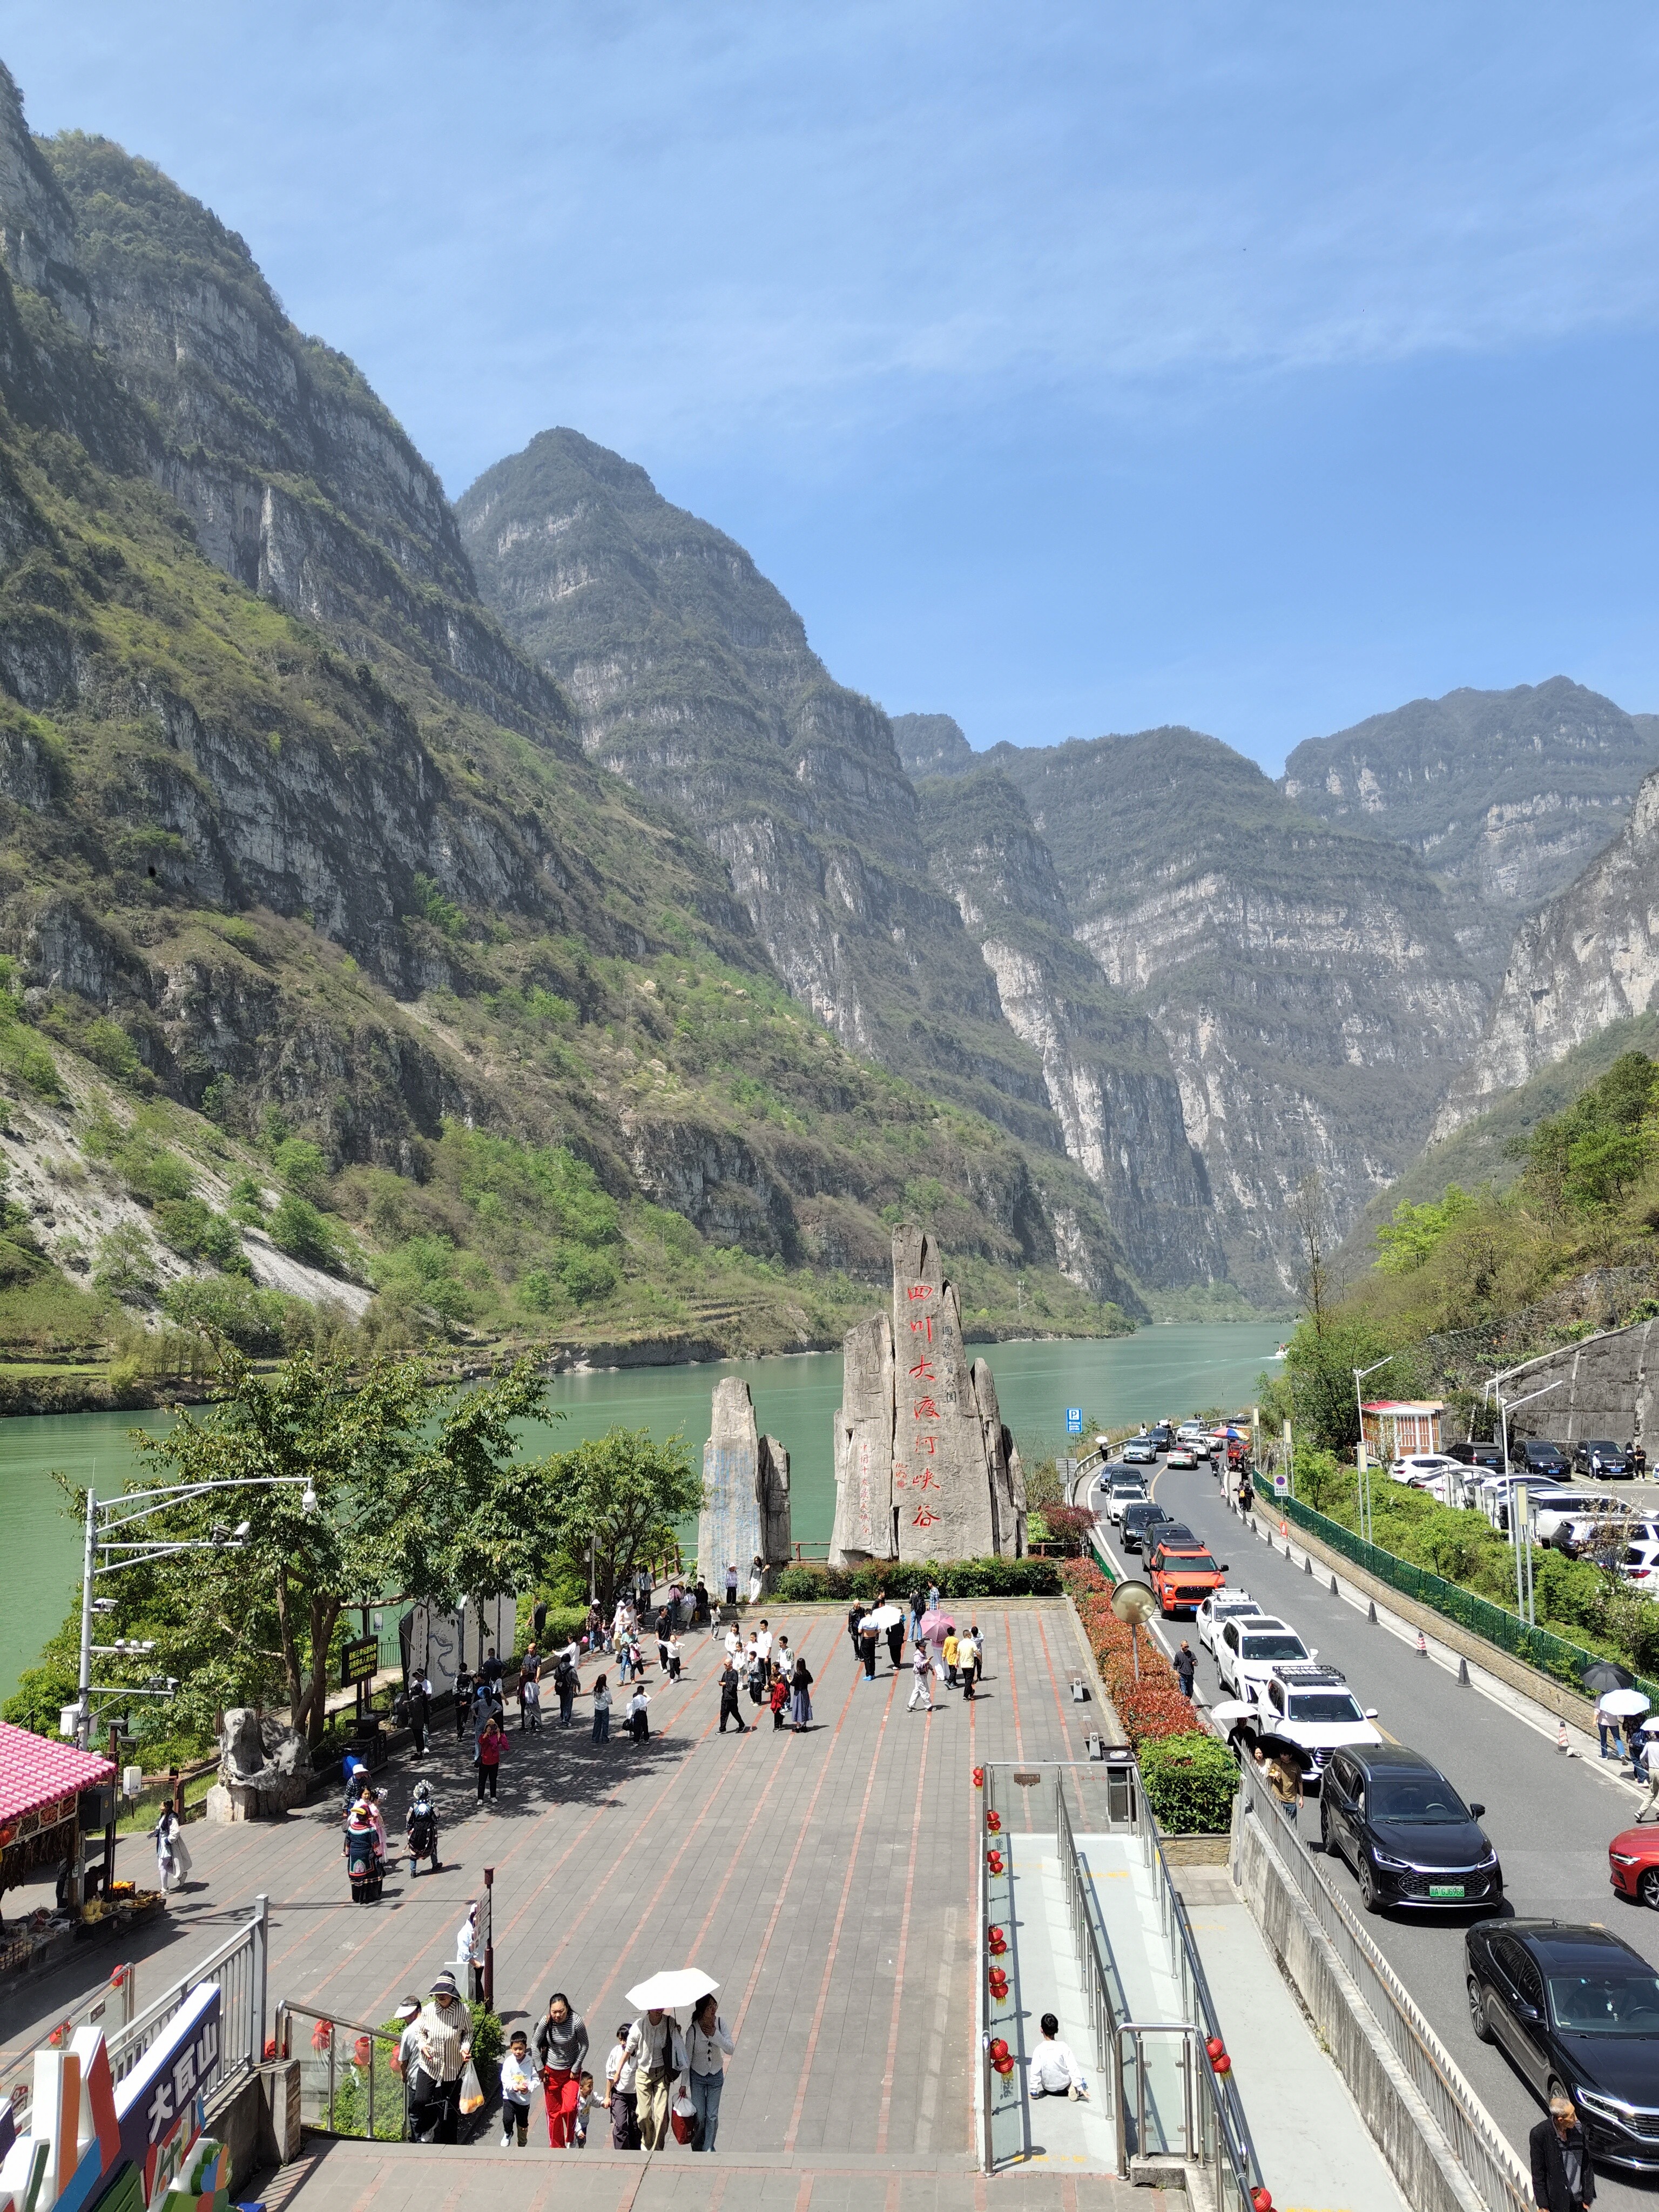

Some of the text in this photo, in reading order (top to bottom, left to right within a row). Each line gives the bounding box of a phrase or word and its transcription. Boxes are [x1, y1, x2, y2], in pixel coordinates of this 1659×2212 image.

[907, 1285, 941, 1527] 四川大渡河峡谷
[1071, 1410, 1077, 1419] P
[148, 2022, 217, 2144] 大瓦山
